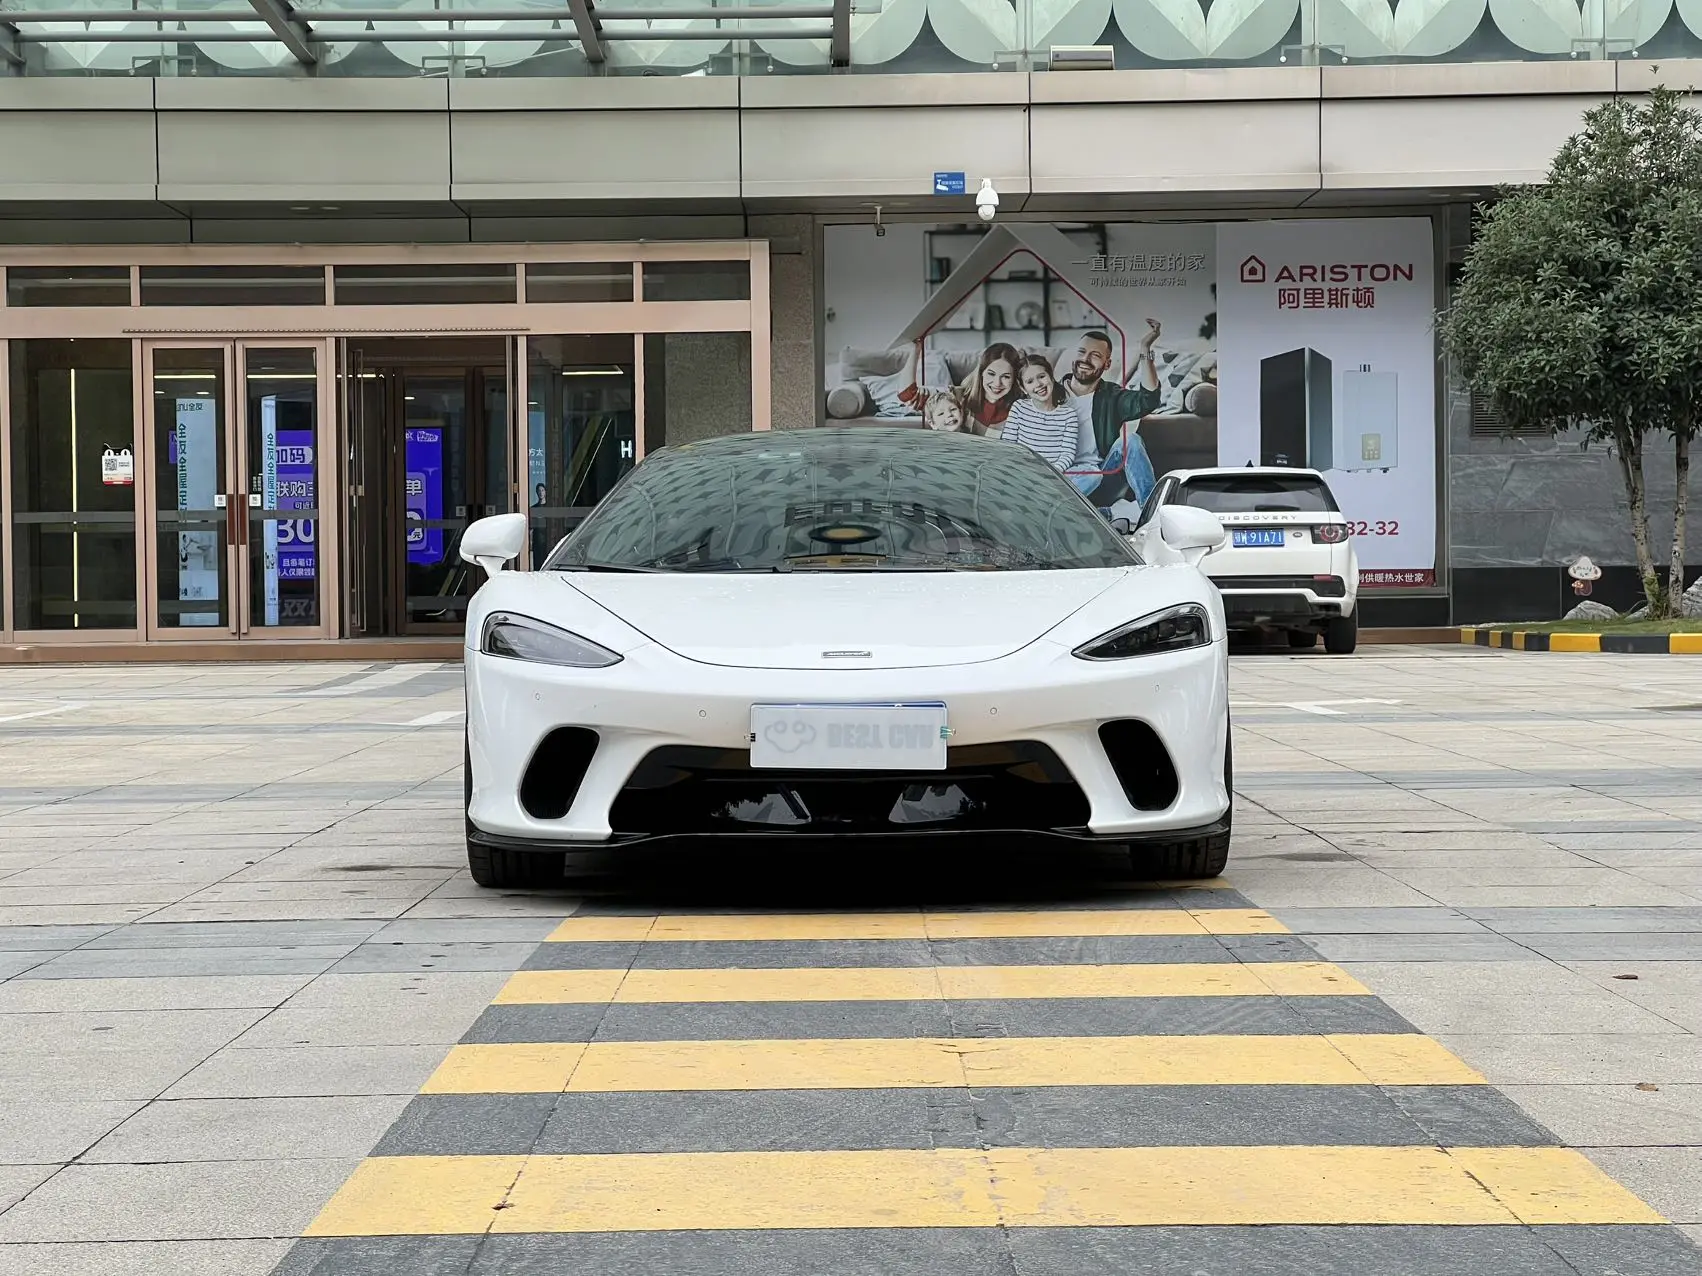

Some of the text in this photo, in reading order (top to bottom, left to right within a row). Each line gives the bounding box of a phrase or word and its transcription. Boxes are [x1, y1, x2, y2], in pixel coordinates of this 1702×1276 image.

[1071, 253, 1206, 271] 一直有温度的家
[1274, 263, 1413, 282] ARISTON
[1278, 287, 1374, 309] 阿里斯顿
